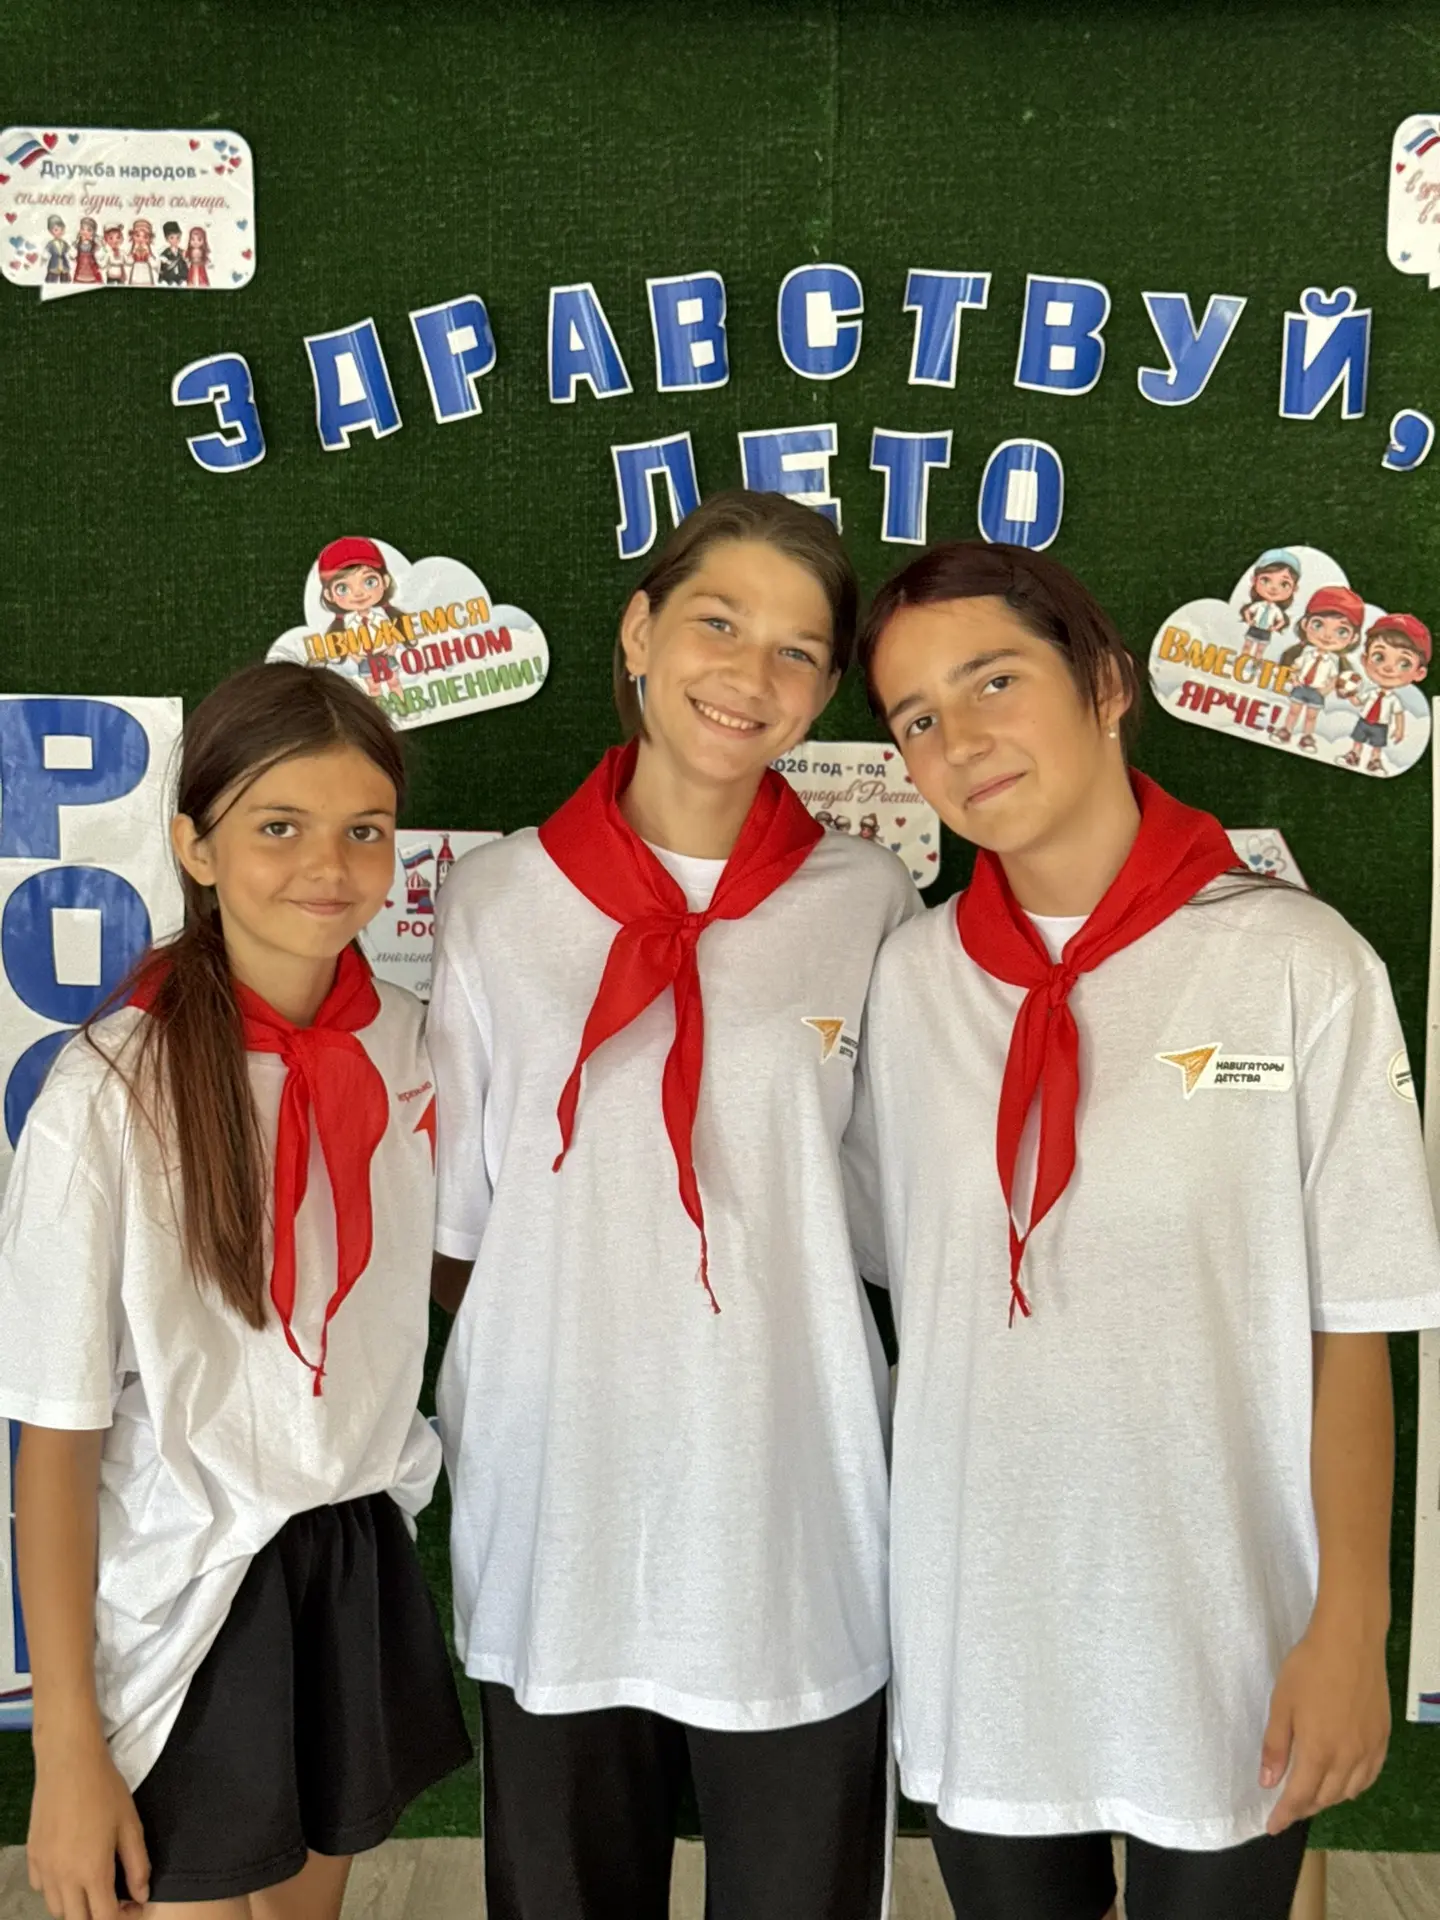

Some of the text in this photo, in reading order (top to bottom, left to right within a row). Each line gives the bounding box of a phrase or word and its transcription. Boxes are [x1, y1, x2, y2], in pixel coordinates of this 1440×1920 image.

[40, 160, 115, 180] Дружба
[119, 165, 196, 182] народов
[172, 263, 1435, 473] ЗДРАВСТВУЙ,
[610, 422, 1065, 560] ЛЕТО
[302, 596, 491, 668] ДВИЖЕМСЯ
[366, 626, 513, 683] В ОДНОМ
[1176, 680, 1283, 734] ЯРЧЕ!
[770, 759, 809, 774] 026
[812, 763, 842, 777] год
[857, 764, 887, 778] год
[797, 779, 862, 809] ародов
[1214, 1073, 1262, 1084] ДЕТСТВА
[1216, 1061, 1285, 1073] НАВИГАТОРЫ
